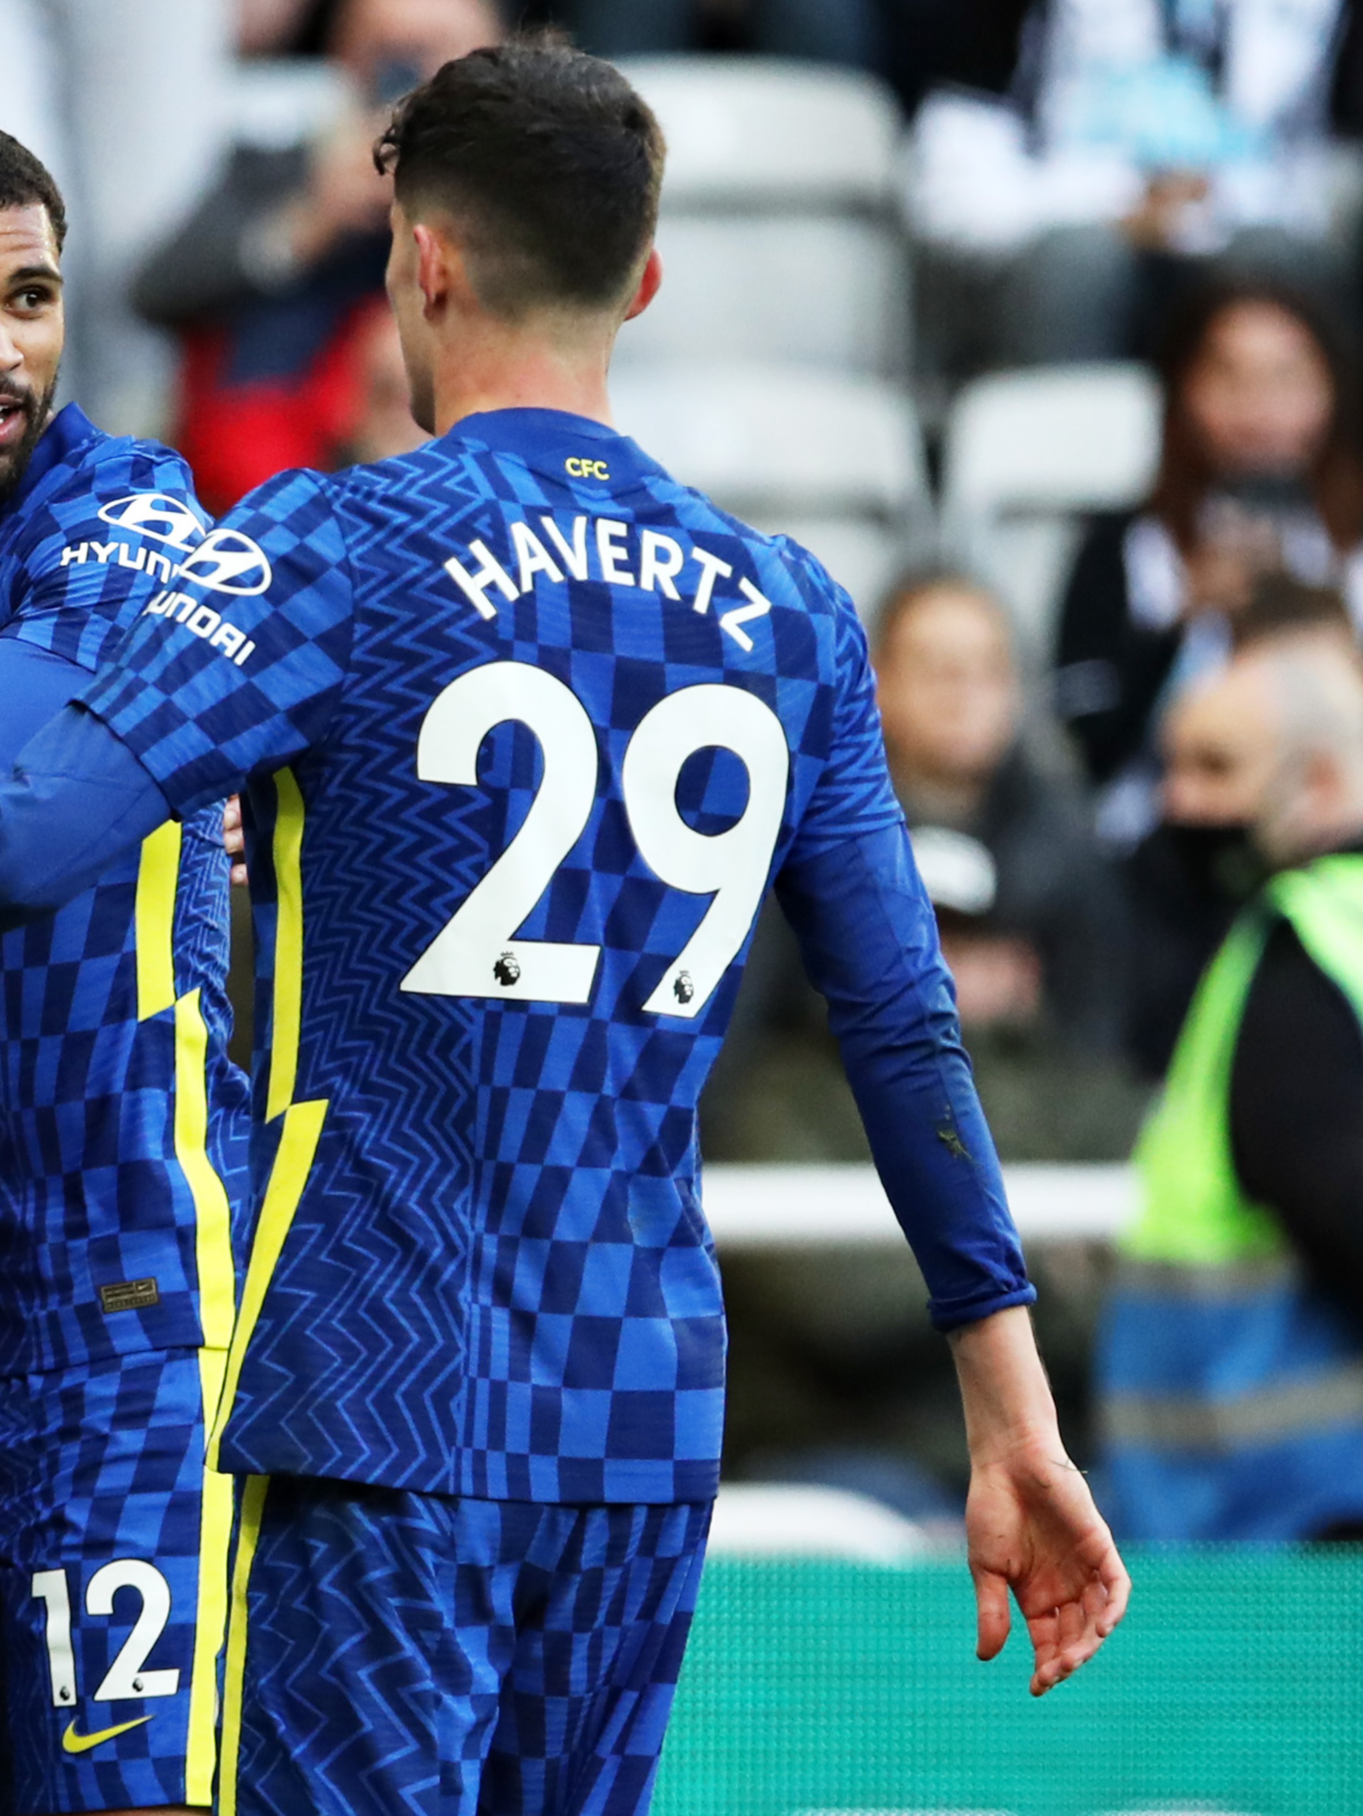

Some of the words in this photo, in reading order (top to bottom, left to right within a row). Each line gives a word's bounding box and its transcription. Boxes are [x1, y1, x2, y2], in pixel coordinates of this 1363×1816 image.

[565, 457, 610, 480] CFC
[60, 542, 180, 584] HYUN
[444, 515, 772, 652] HAVERTZ
[142, 590, 256, 666] UNDAI
[399, 660, 790, 1019] 29
[31, 1558, 181, 1708] 12
